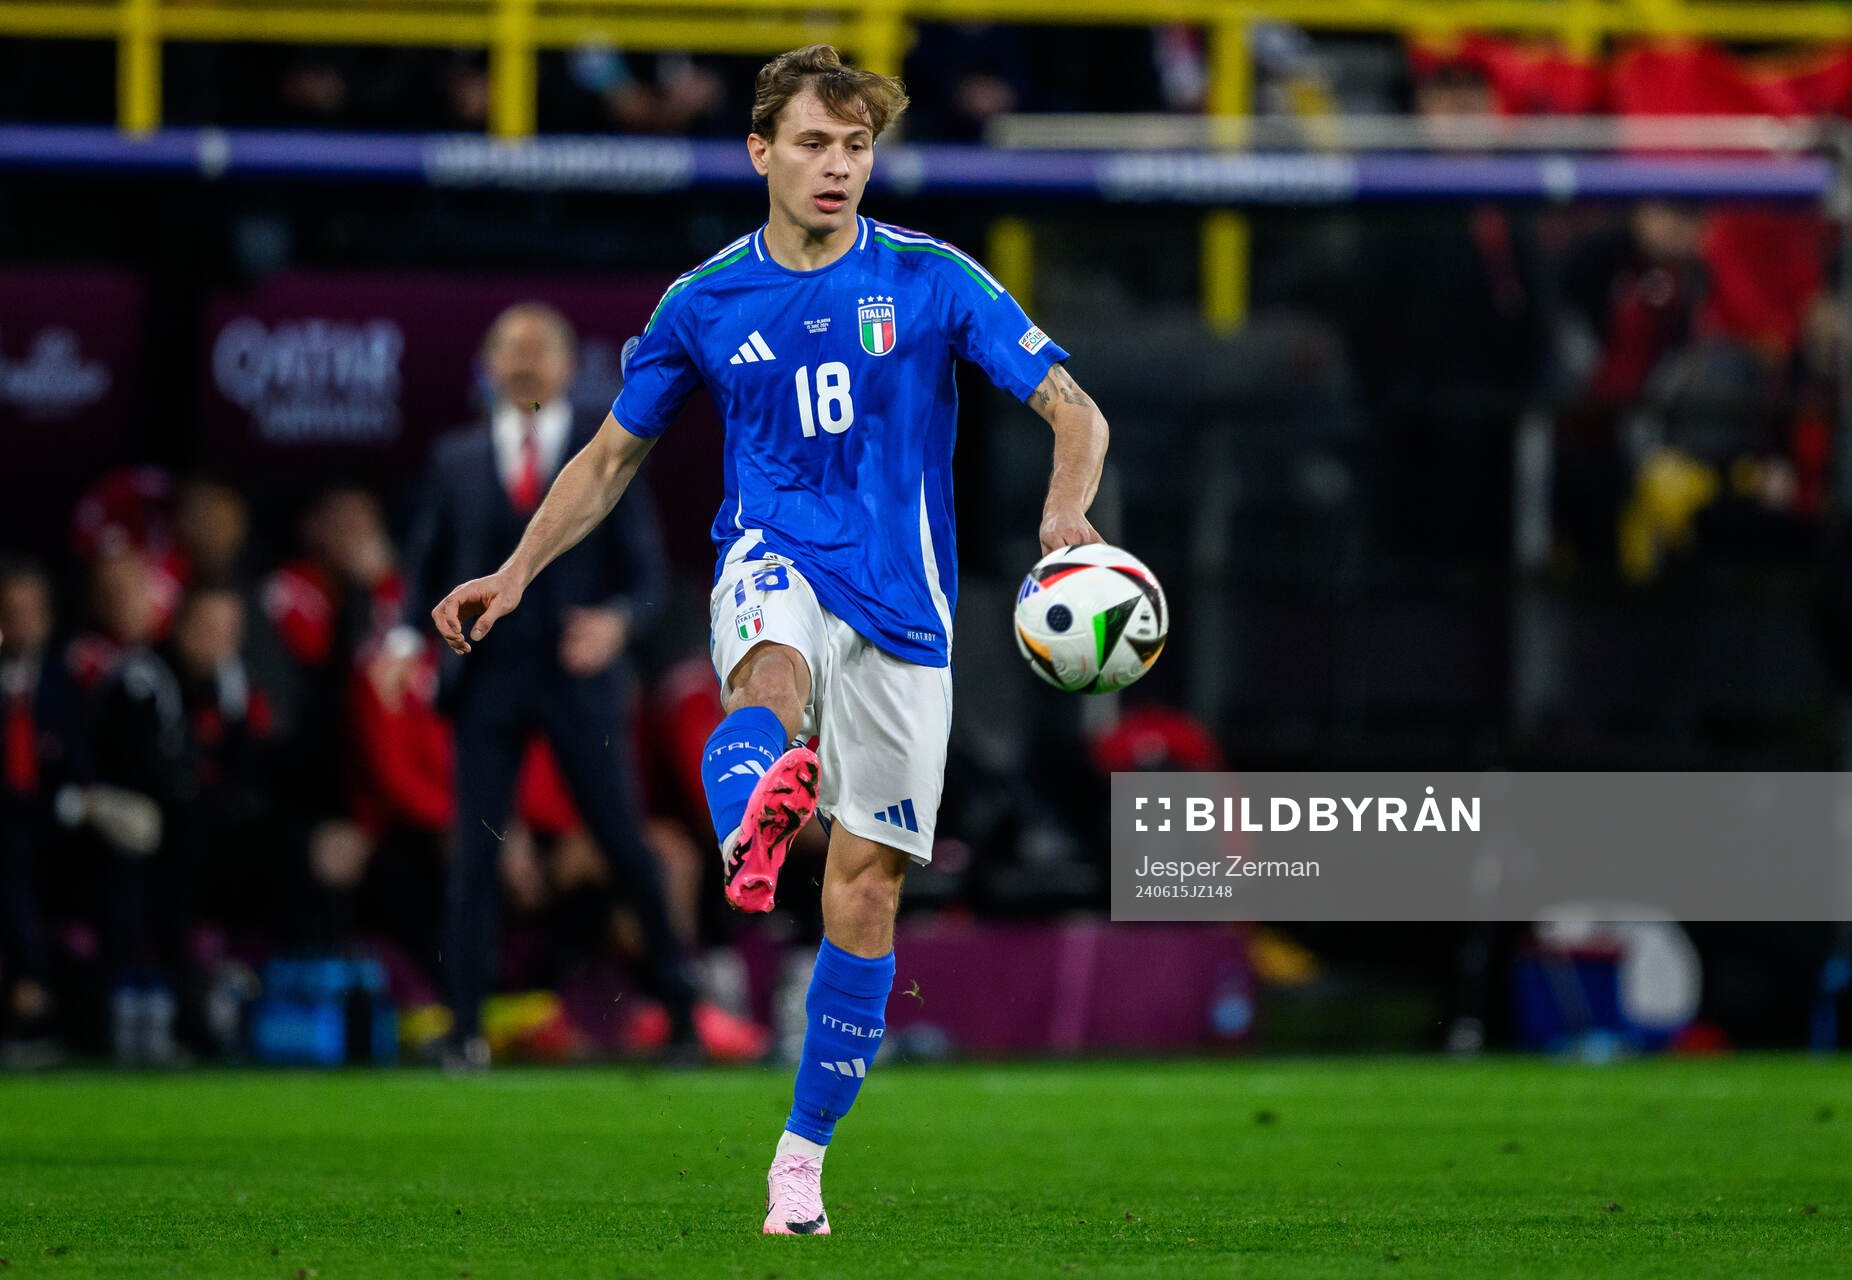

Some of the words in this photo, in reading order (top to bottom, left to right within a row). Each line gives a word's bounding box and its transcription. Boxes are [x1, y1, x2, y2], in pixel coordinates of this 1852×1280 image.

[861, 308, 892, 320] ITALIA
[795, 361, 855, 438] 18
[737, 611, 760, 625] ITALIA
[708, 741, 775, 763] ITALIA
[822, 1013, 885, 1039] ITALIA
